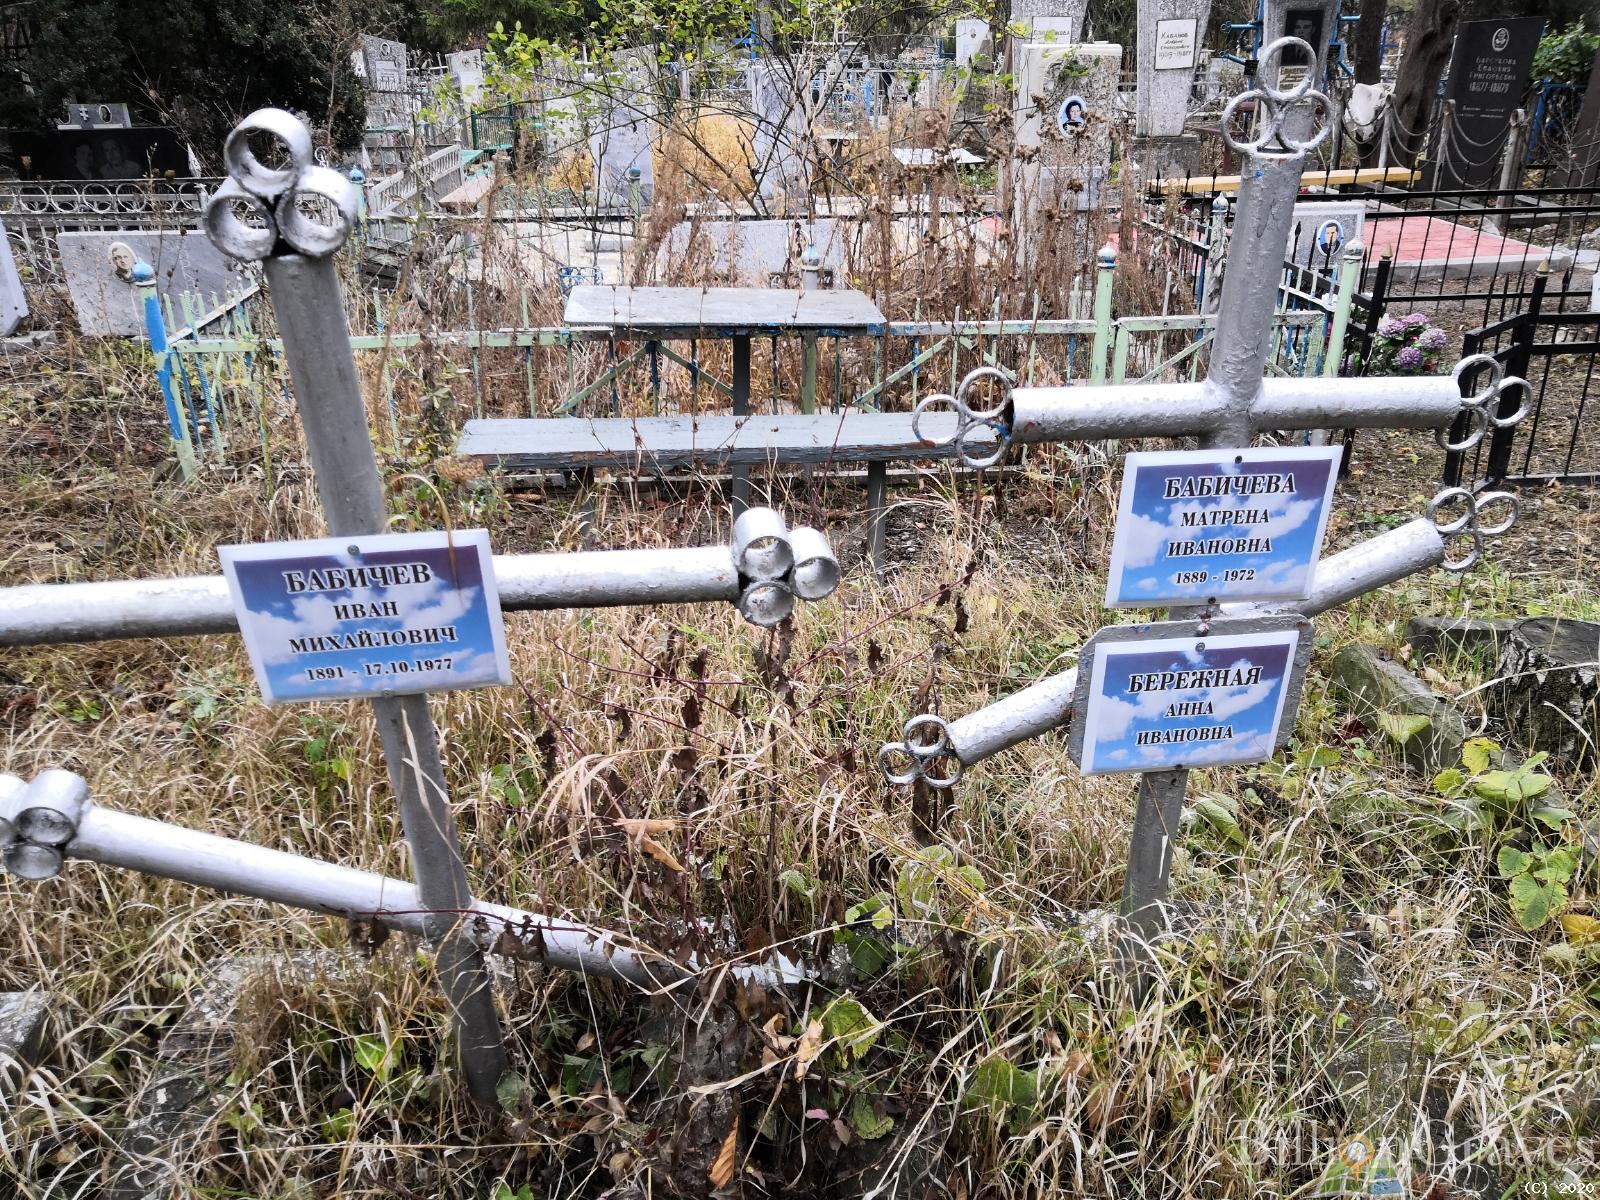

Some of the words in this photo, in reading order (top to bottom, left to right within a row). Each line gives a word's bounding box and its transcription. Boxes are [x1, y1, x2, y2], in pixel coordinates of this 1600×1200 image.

[1165, 473, 1296, 498] БАБИЧЕВА
[1180, 509, 1269, 526] МАТРЕНА
[1167, 538, 1272, 557] ИВАНОВНА
[284, 563, 432, 593] БАБИЧЕВ
[1176, 571, 1207, 584] 1889
[1224, 569, 1255, 582] 1972
[334, 601, 399, 620] ИВАН
[289, 626, 457, 653] МИХАЙЛОВИЧ
[306, 667, 343, 681] 1891
[364, 659, 452, 676] 17.10.1977
[1128, 667, 1263, 693] БЕРЕЖНАЯ
[1164, 701, 1214, 717] АННА
[1136, 726, 1233, 745] ИВАНОВНА
